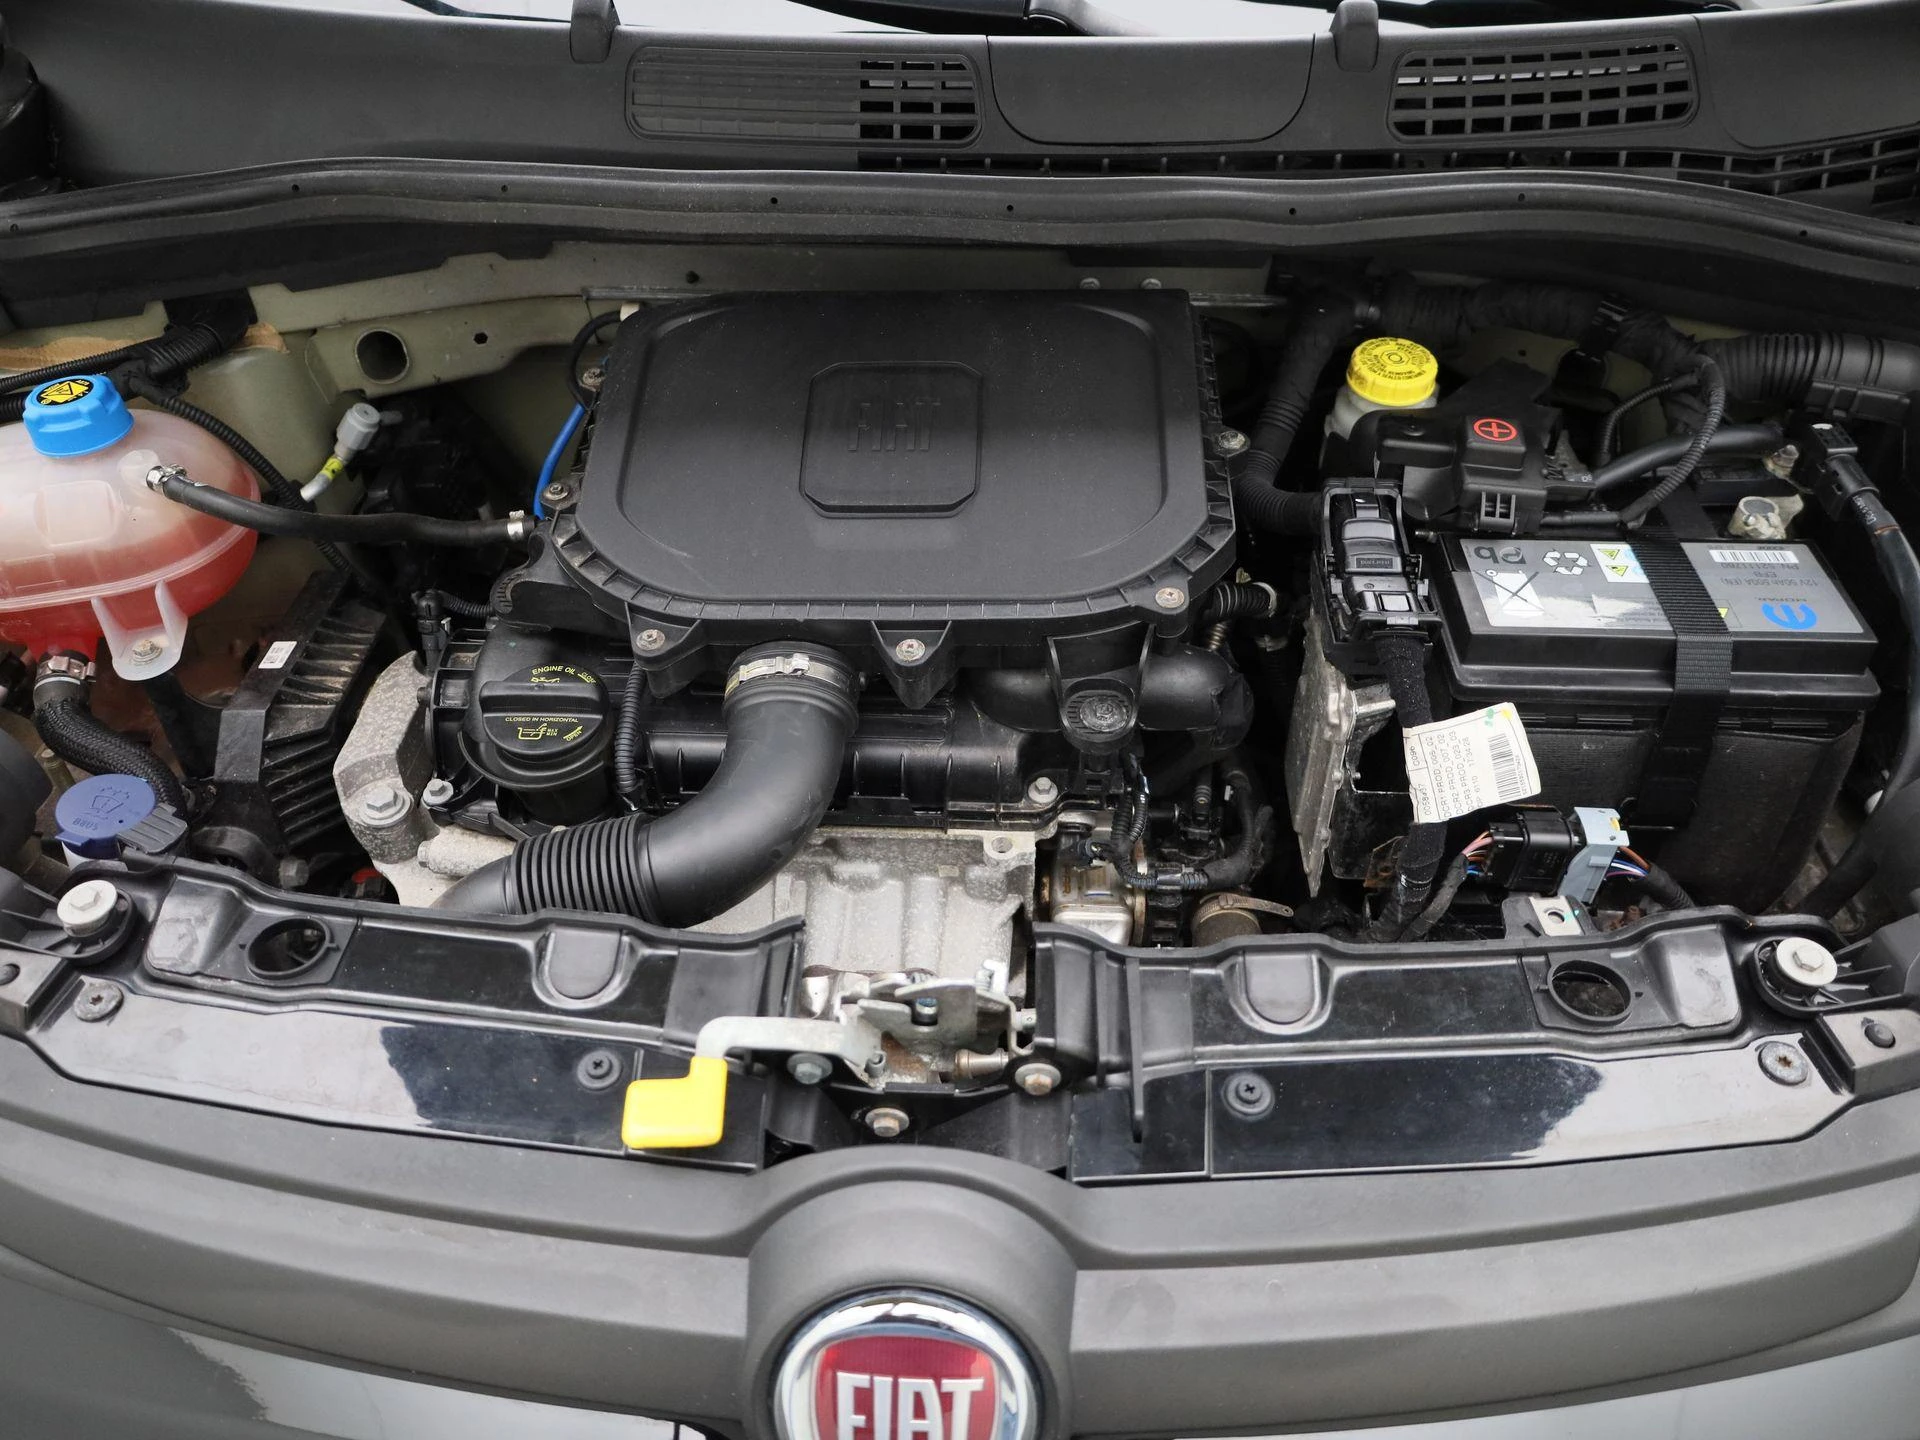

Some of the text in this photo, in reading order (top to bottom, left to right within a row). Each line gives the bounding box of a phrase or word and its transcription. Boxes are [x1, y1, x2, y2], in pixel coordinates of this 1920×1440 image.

[848, 399, 941, 453] FIAT
[531, 665, 576, 676] ENGINE OIL
[566, 730, 583, 742] OPEN
[836, 1371, 985, 1440] FIAT
